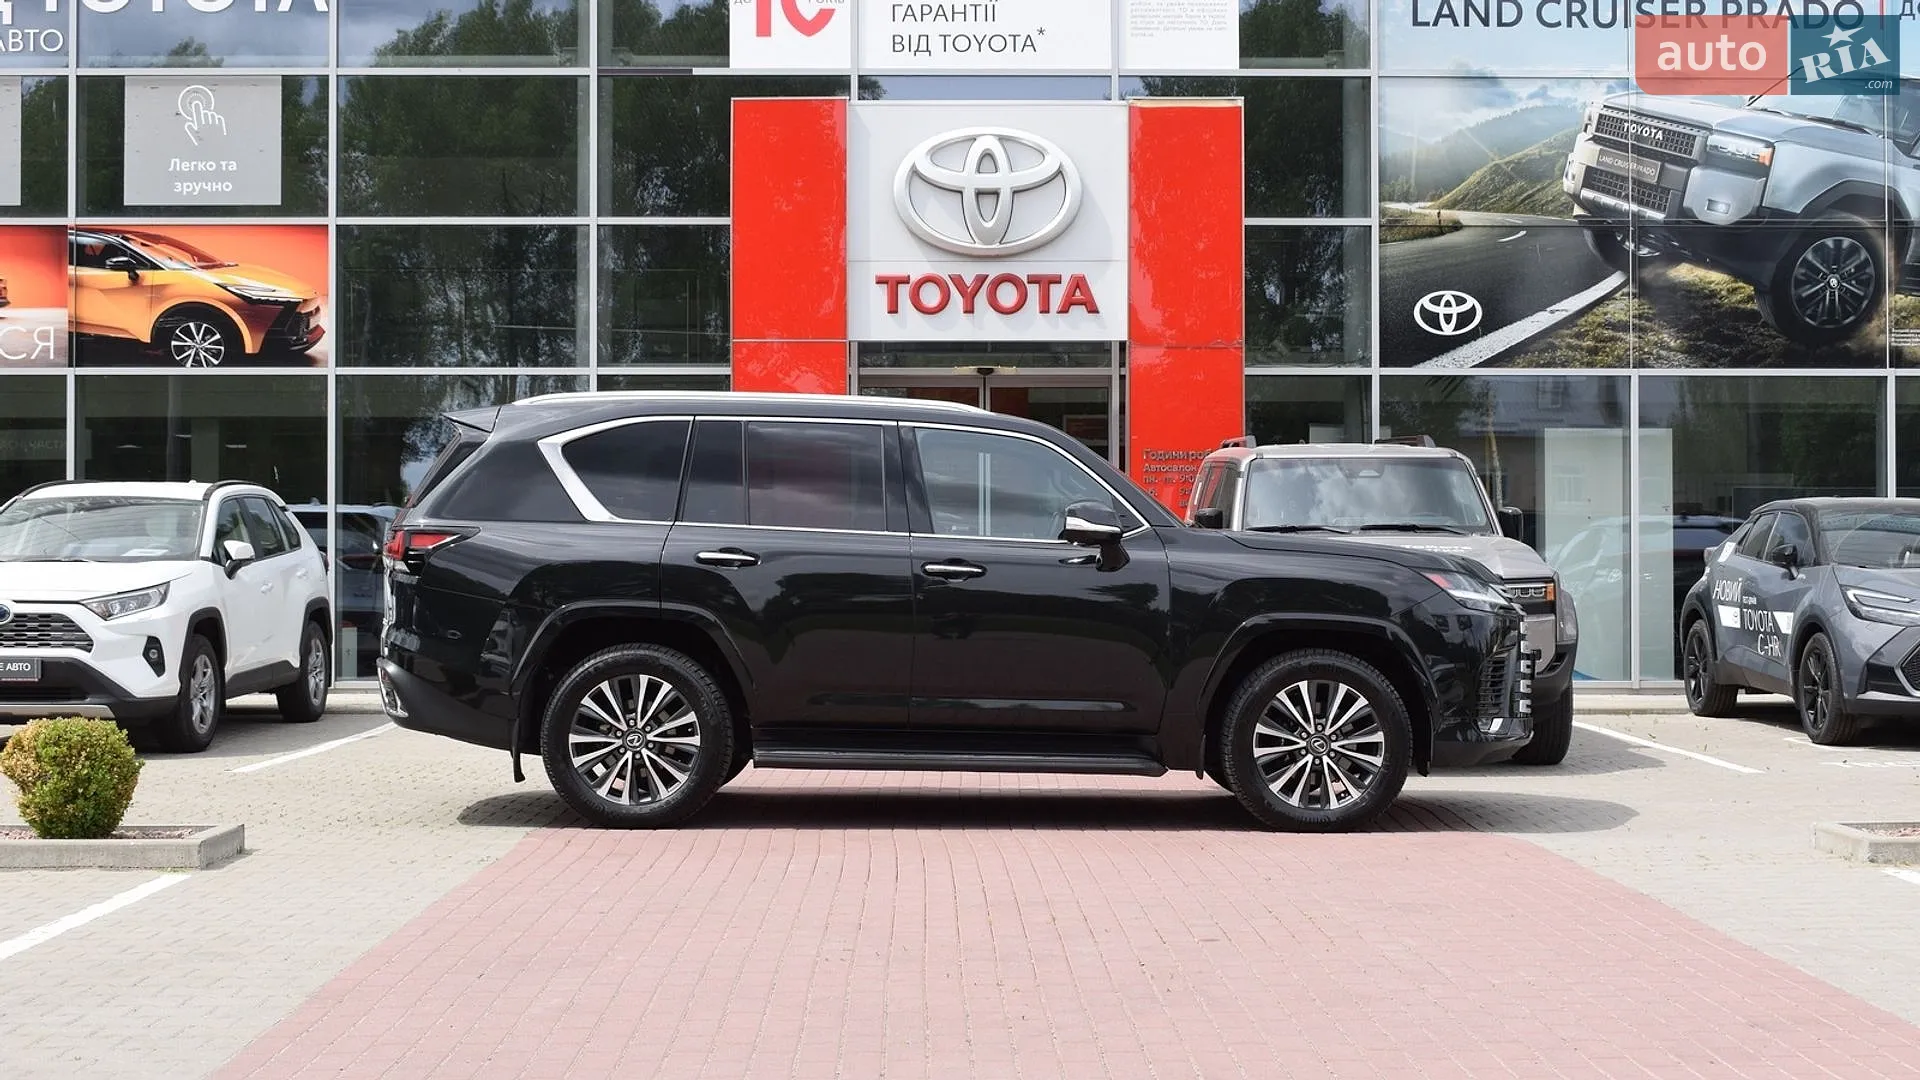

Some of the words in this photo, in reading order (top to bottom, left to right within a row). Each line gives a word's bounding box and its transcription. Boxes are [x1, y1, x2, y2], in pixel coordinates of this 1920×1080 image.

[892, 0, 998, 22] ГАРАНТІЇ
[1412, 0, 1523, 27] LAND
[1536, 0, 1708, 28] CRUISER
[1722, 0, 1864, 29] PRADO
[892, 34, 931, 56] ВІД
[1623, 122, 1663, 140] TOYOTA
[168, 158, 216, 171] Легко
[220, 160, 237, 171] та
[174, 181, 233, 195] зручно
[875, 273, 1100, 315] TOYOTA
[1712, 577, 1743, 603] НОВИЙ
[1742, 608, 1775, 632] TOYOTA
[1757, 633, 1782, 657] C-HR
[5, 662, 32, 671] АВТО
